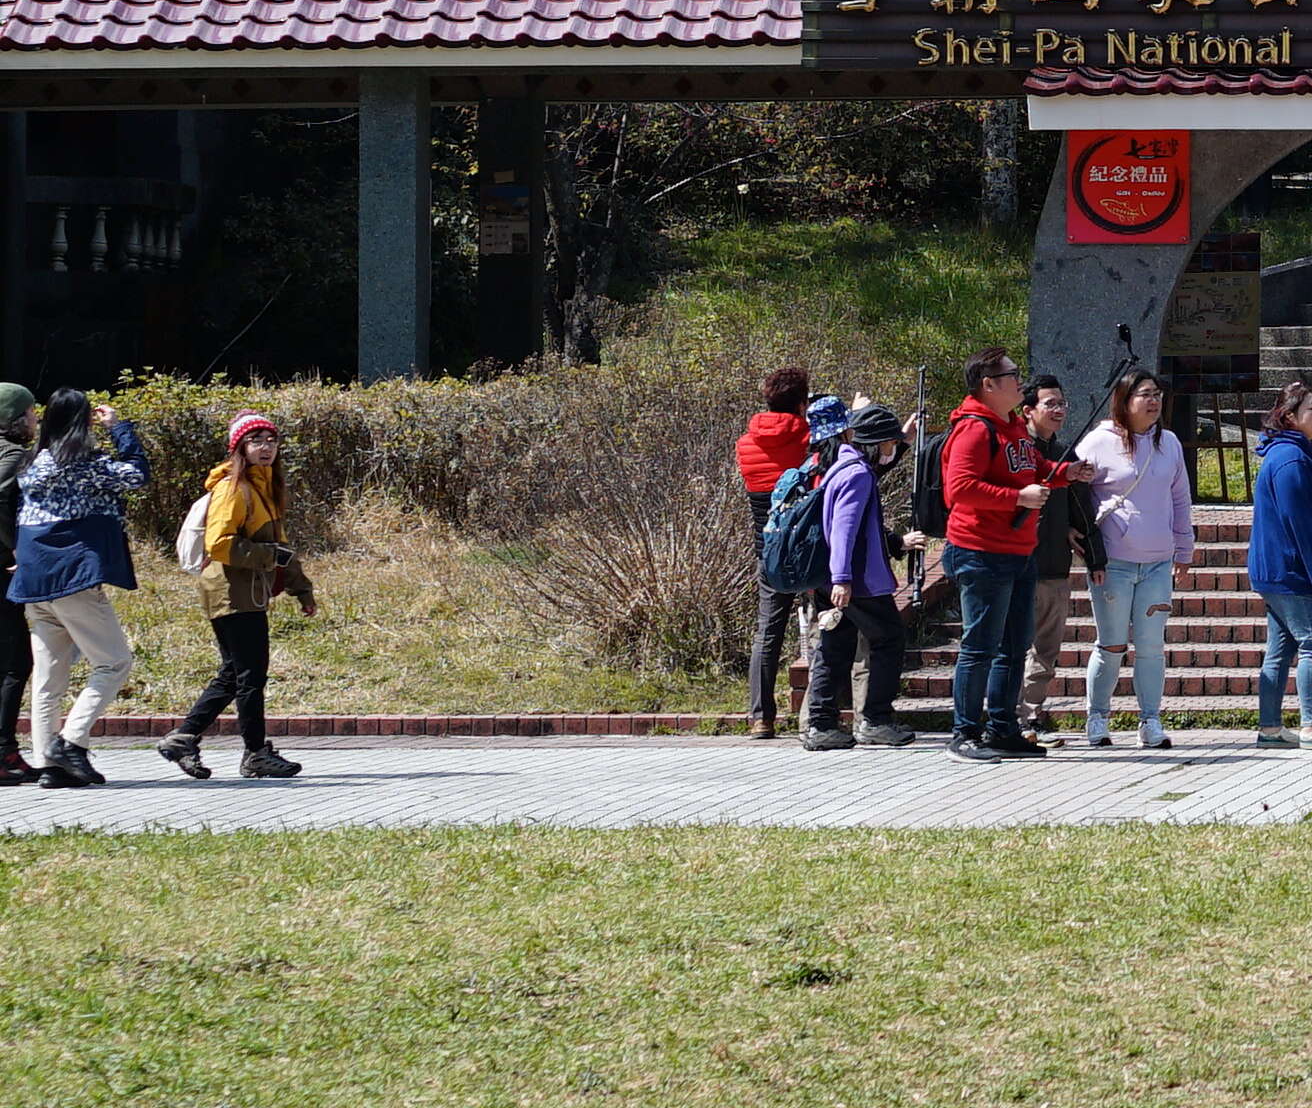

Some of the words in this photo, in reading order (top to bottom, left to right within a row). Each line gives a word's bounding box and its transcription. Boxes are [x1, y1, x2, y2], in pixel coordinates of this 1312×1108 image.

[912, 27, 1087, 66] Shei-Pa
[1106, 26, 1291, 65] National
[1089, 165, 1168, 183] 紀念禮品
